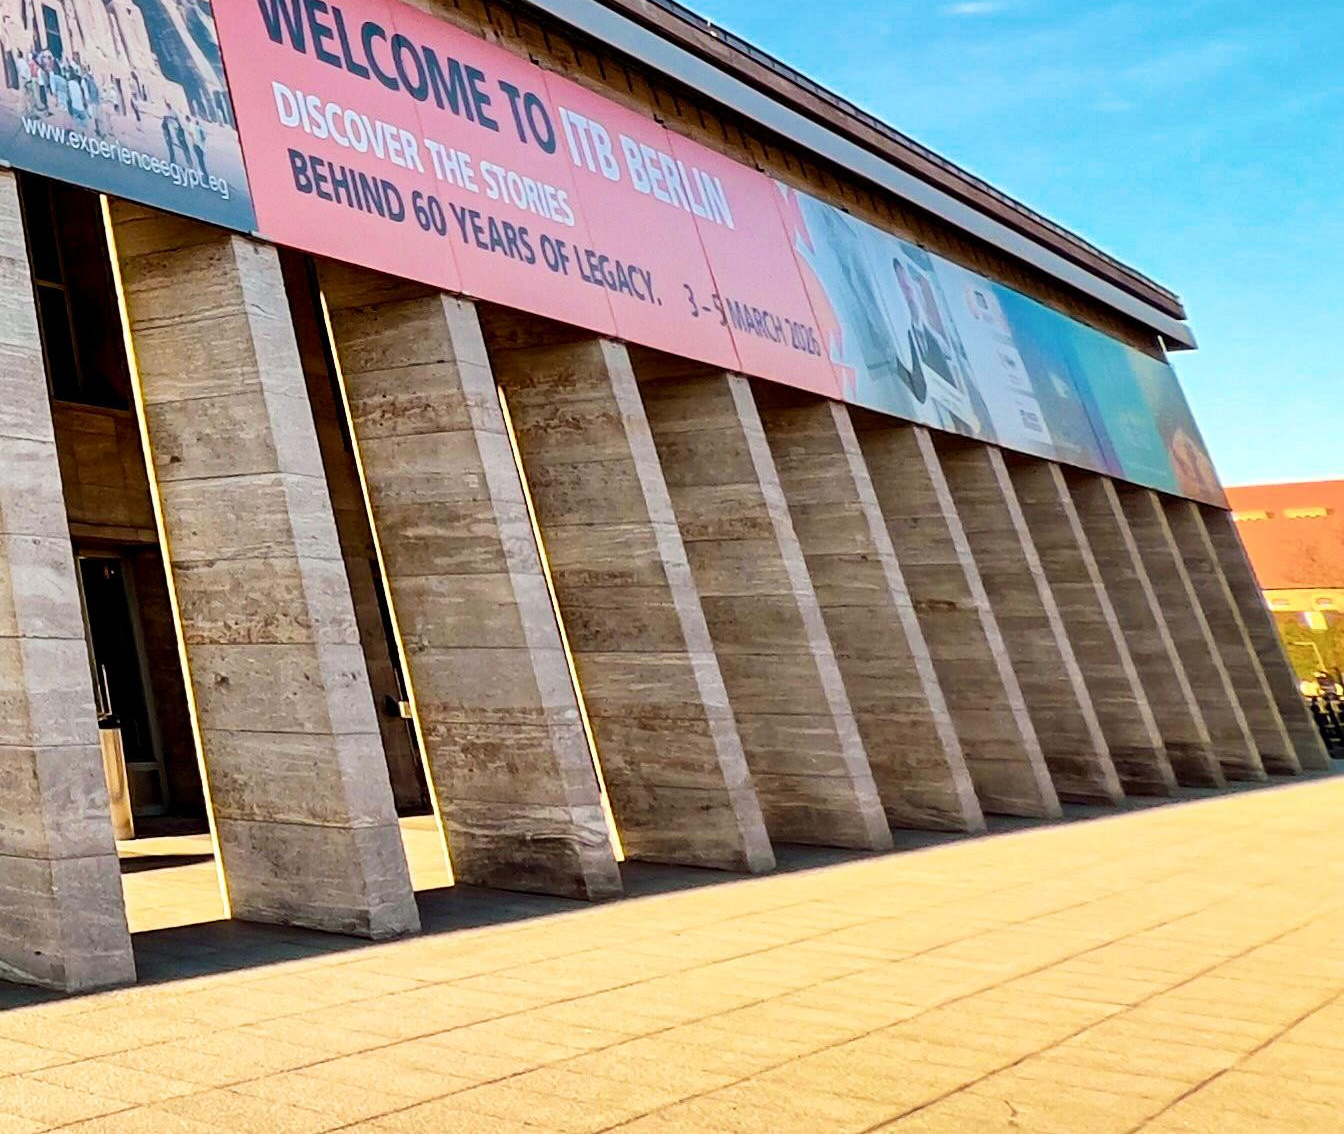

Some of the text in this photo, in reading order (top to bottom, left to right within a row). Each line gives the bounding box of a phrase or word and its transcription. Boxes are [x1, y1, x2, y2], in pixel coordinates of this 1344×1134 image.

[21, 116, 230, 200] www.experienceegypt.eg
[271, 81, 576, 227] DISCOVER THE STORIES
[287, 148, 663, 306] BEHIND 60 YEARS OF LEGACY.
[498, 79, 557, 155] TO
[558, 106, 621, 182] ITB
[619, 134, 736, 231] BERLIN
[725, 297, 788, 346] MARCH
[785, 318, 822, 356] 2026
